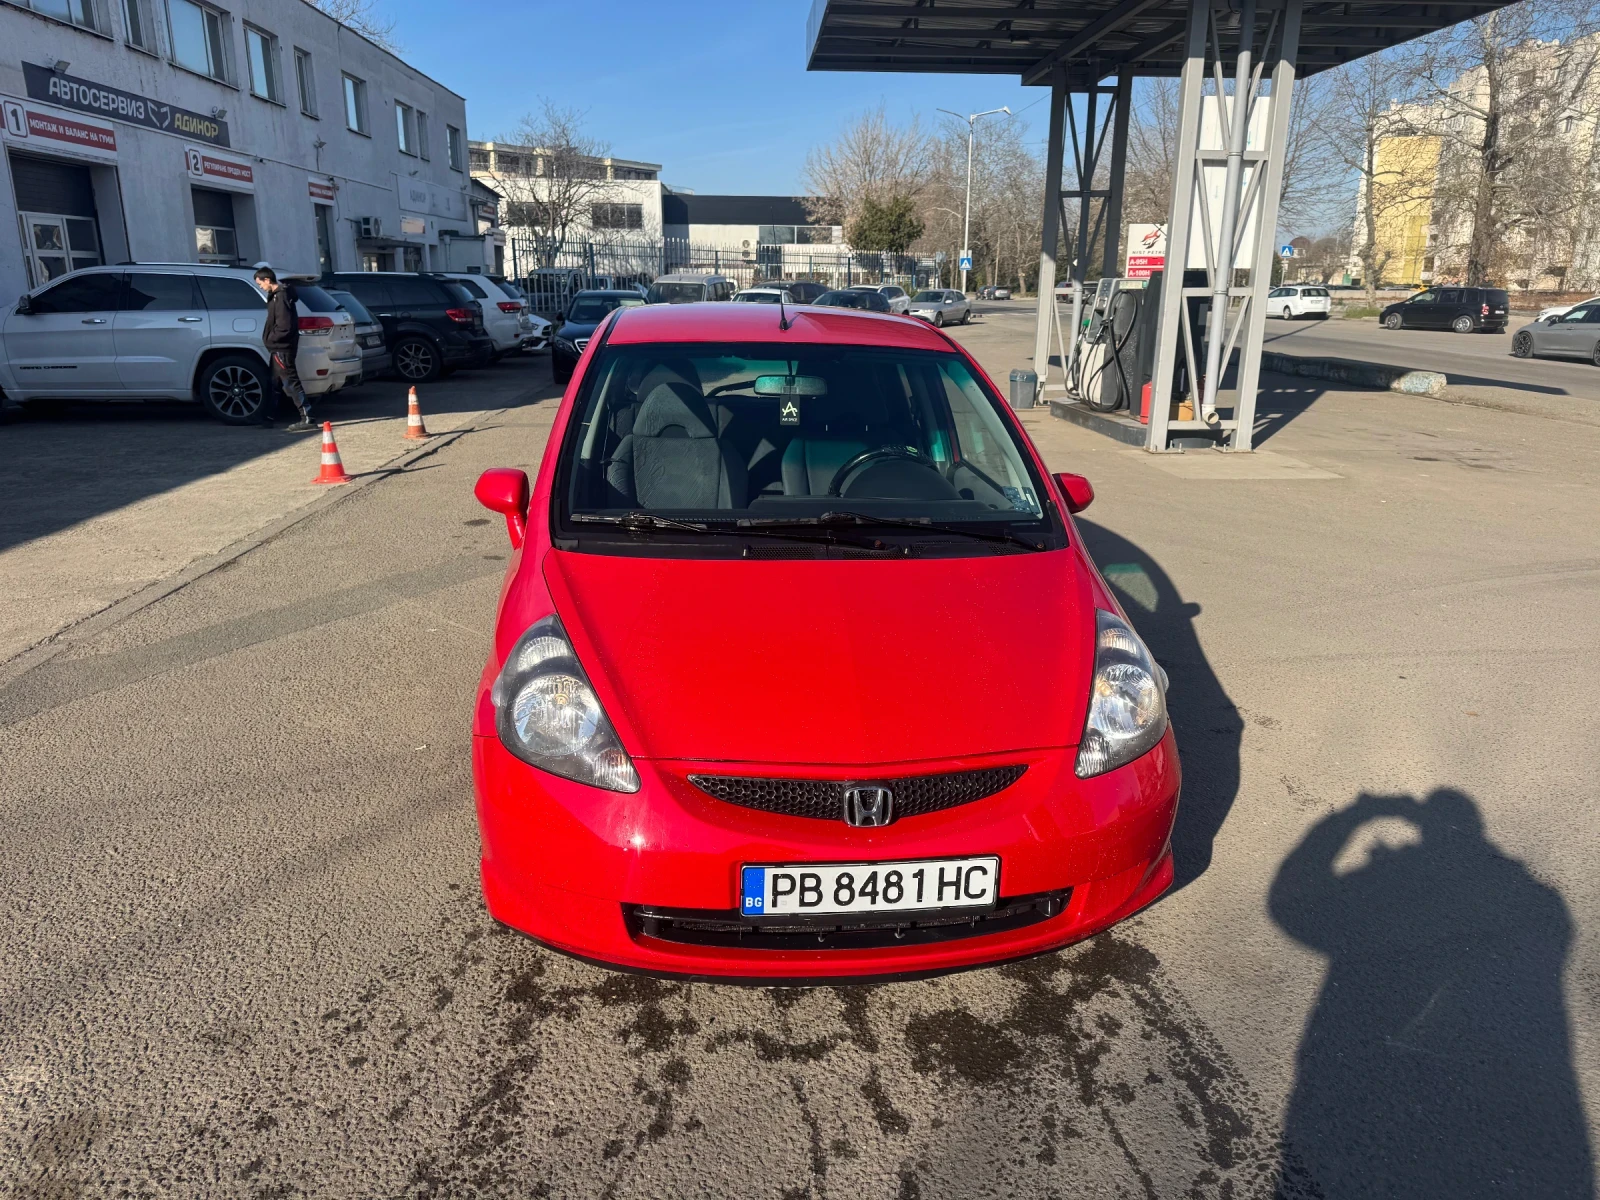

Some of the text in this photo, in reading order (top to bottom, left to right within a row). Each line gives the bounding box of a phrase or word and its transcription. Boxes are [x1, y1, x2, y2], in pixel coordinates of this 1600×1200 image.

[10, 108, 21, 132] 1
[49, 77, 219, 138] АВТОСЕРВИЗ АДИНОР
[29, 118, 115, 145] МОНТАЖ И БАЛАНС НА ГУМИ
[192, 154, 201, 172] 2
[771, 865, 988, 909] PB 8481 HC
[745, 896, 763, 908] BG
